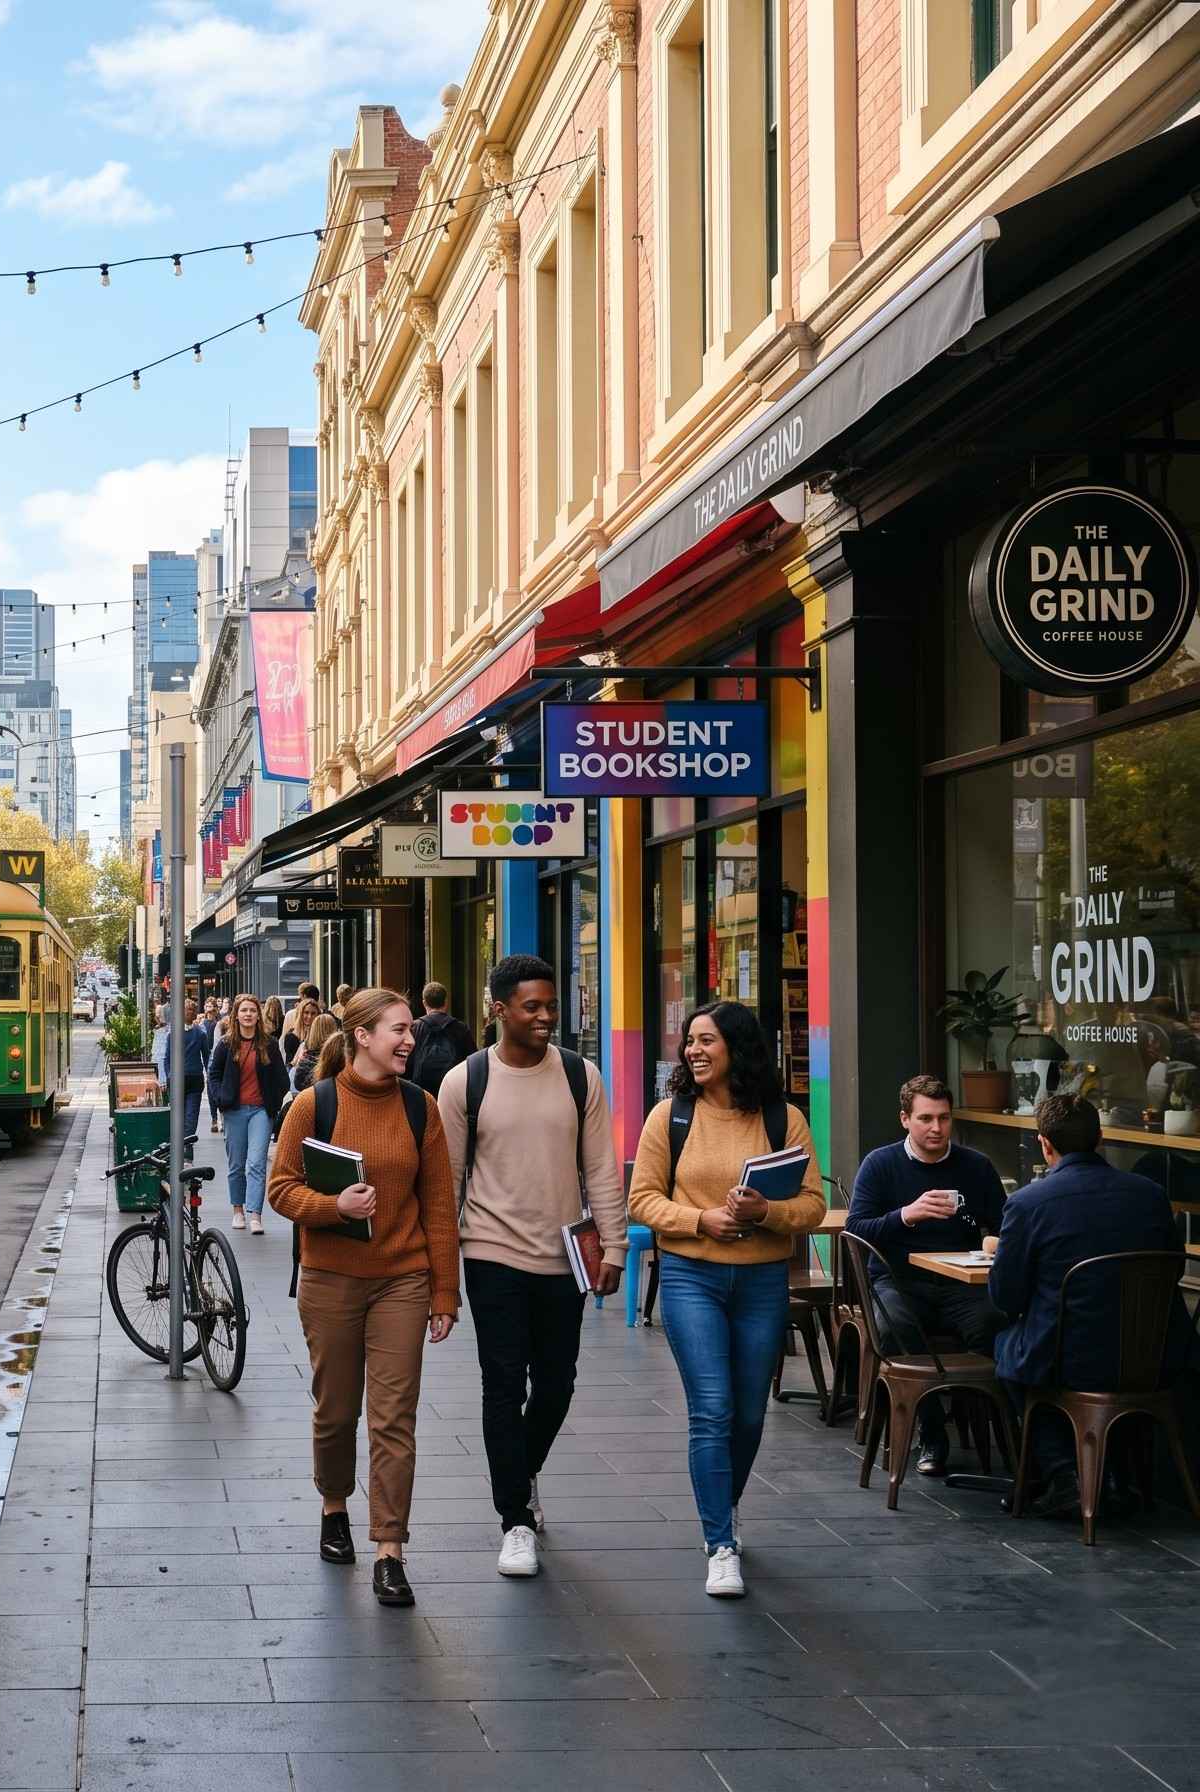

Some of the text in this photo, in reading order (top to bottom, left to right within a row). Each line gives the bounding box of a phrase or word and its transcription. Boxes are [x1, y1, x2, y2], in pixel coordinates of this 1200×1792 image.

[694, 415, 803, 537] THE DAILY GRIND
[1074, 525, 1108, 539] THE
[1030, 546, 1151, 582] DAILY
[1030, 588, 1155, 621] GRIND
[1042, 631, 1143, 641] COFFEE HOUSE
[575, 720, 733, 746] STUDENT
[559, 752, 751, 778] BOOKSHOP
[450, 803, 575, 823] STUDENT
[8, 856, 39, 875] W
[1089, 865, 1108, 884] THE
[1075, 890, 1124, 928] DAILY
[1051, 936, 1155, 1005] GRIND
[1066, 1025, 1138, 1043] COFFEE HOUSE
